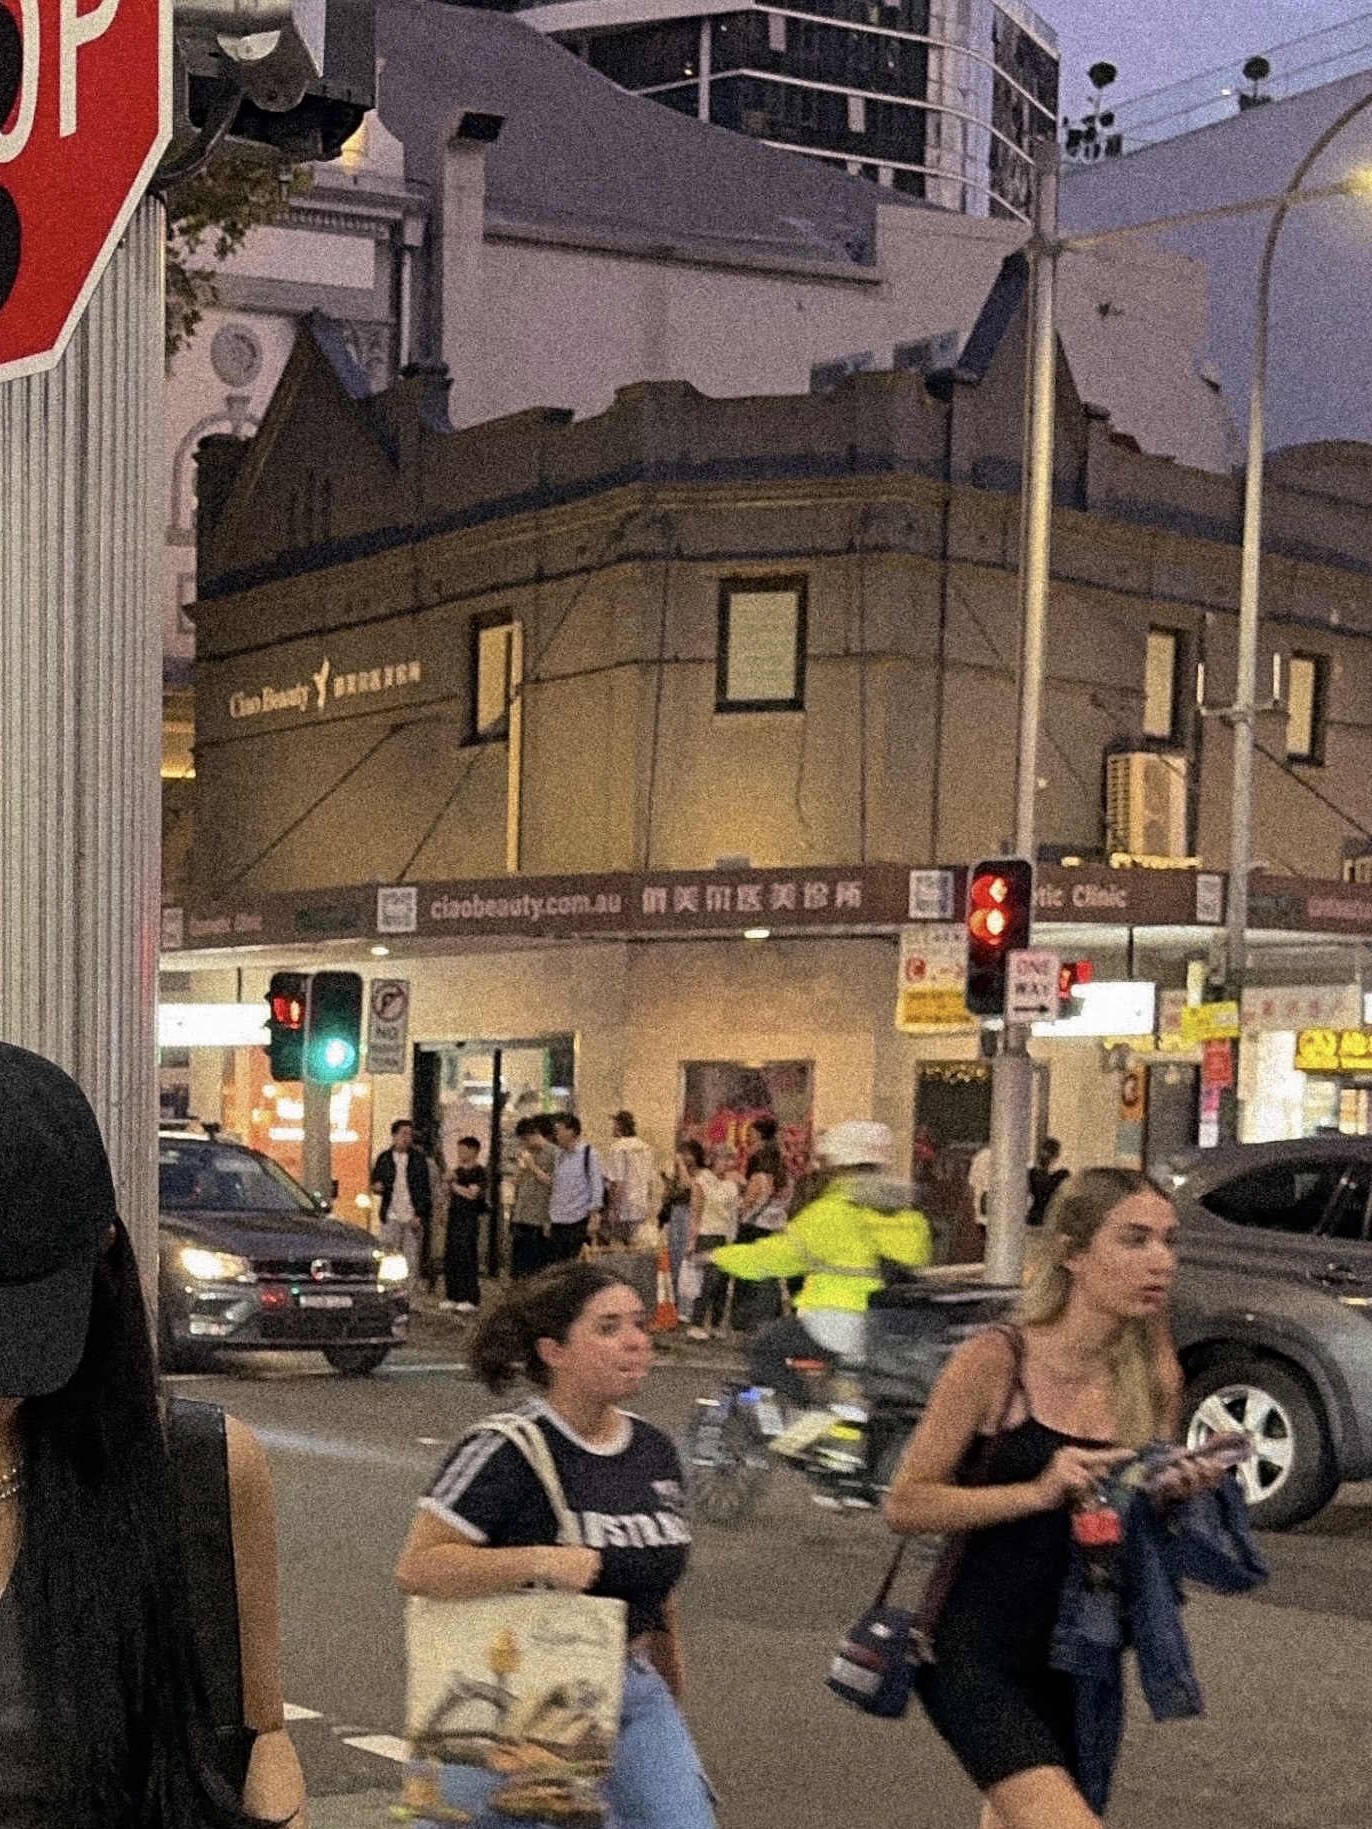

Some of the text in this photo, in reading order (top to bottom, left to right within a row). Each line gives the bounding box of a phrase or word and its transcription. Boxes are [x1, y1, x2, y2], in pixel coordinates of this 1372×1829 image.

[262, 682, 310, 713] Beauty
[429, 888, 623, 922] ciaobeauty.com.au
[1072, 883, 1128, 908] Clinic
[1016, 957, 1051, 976] ONE
[1014, 981, 1051, 997] WAY
